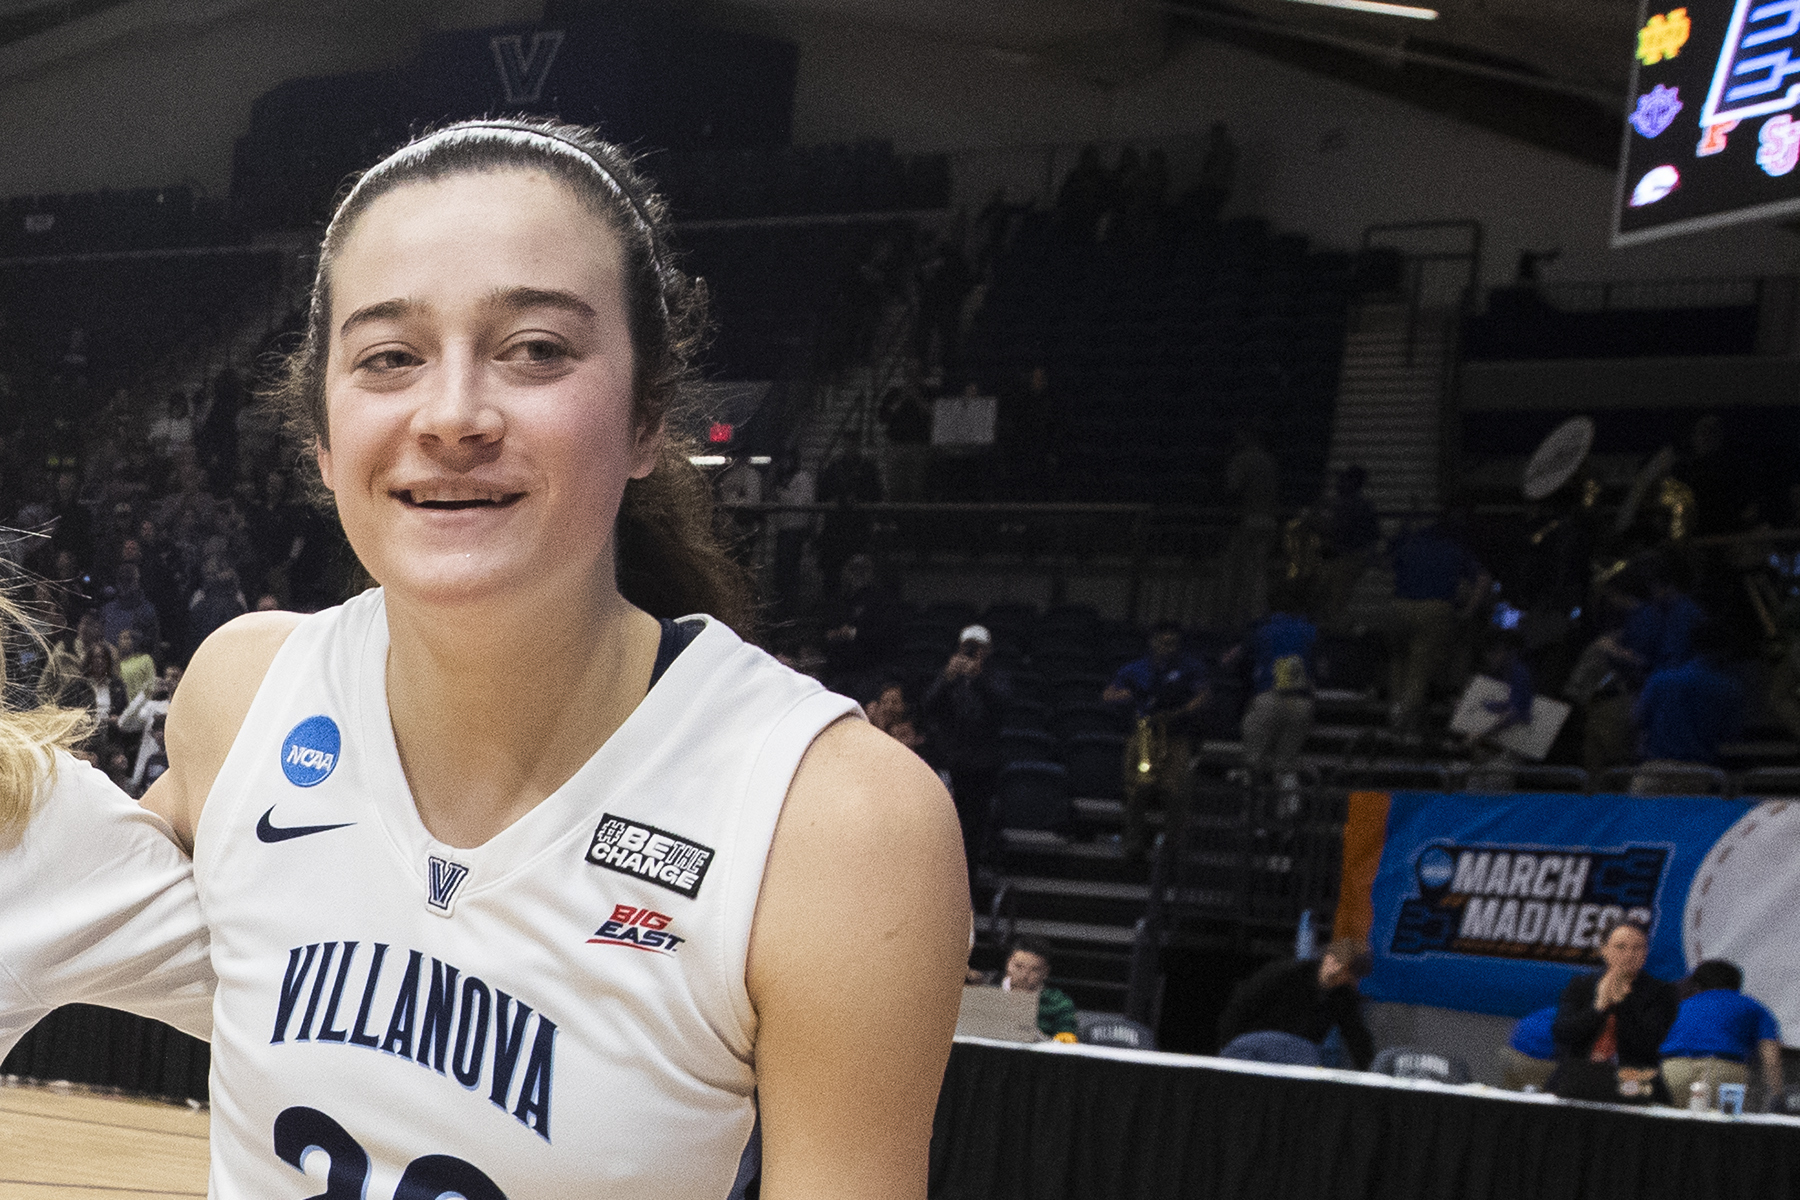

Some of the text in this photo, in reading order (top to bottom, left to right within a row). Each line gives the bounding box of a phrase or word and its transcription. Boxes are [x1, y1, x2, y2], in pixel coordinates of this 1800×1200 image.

[286, 745, 334, 771] NCAA
[428, 856, 470, 910] V
[591, 843, 699, 890] CHANGE
[1451, 851, 1592, 899] MARCH
[609, 904, 673, 930] BIG
[269, 941, 560, 1145] VILLANOVA
